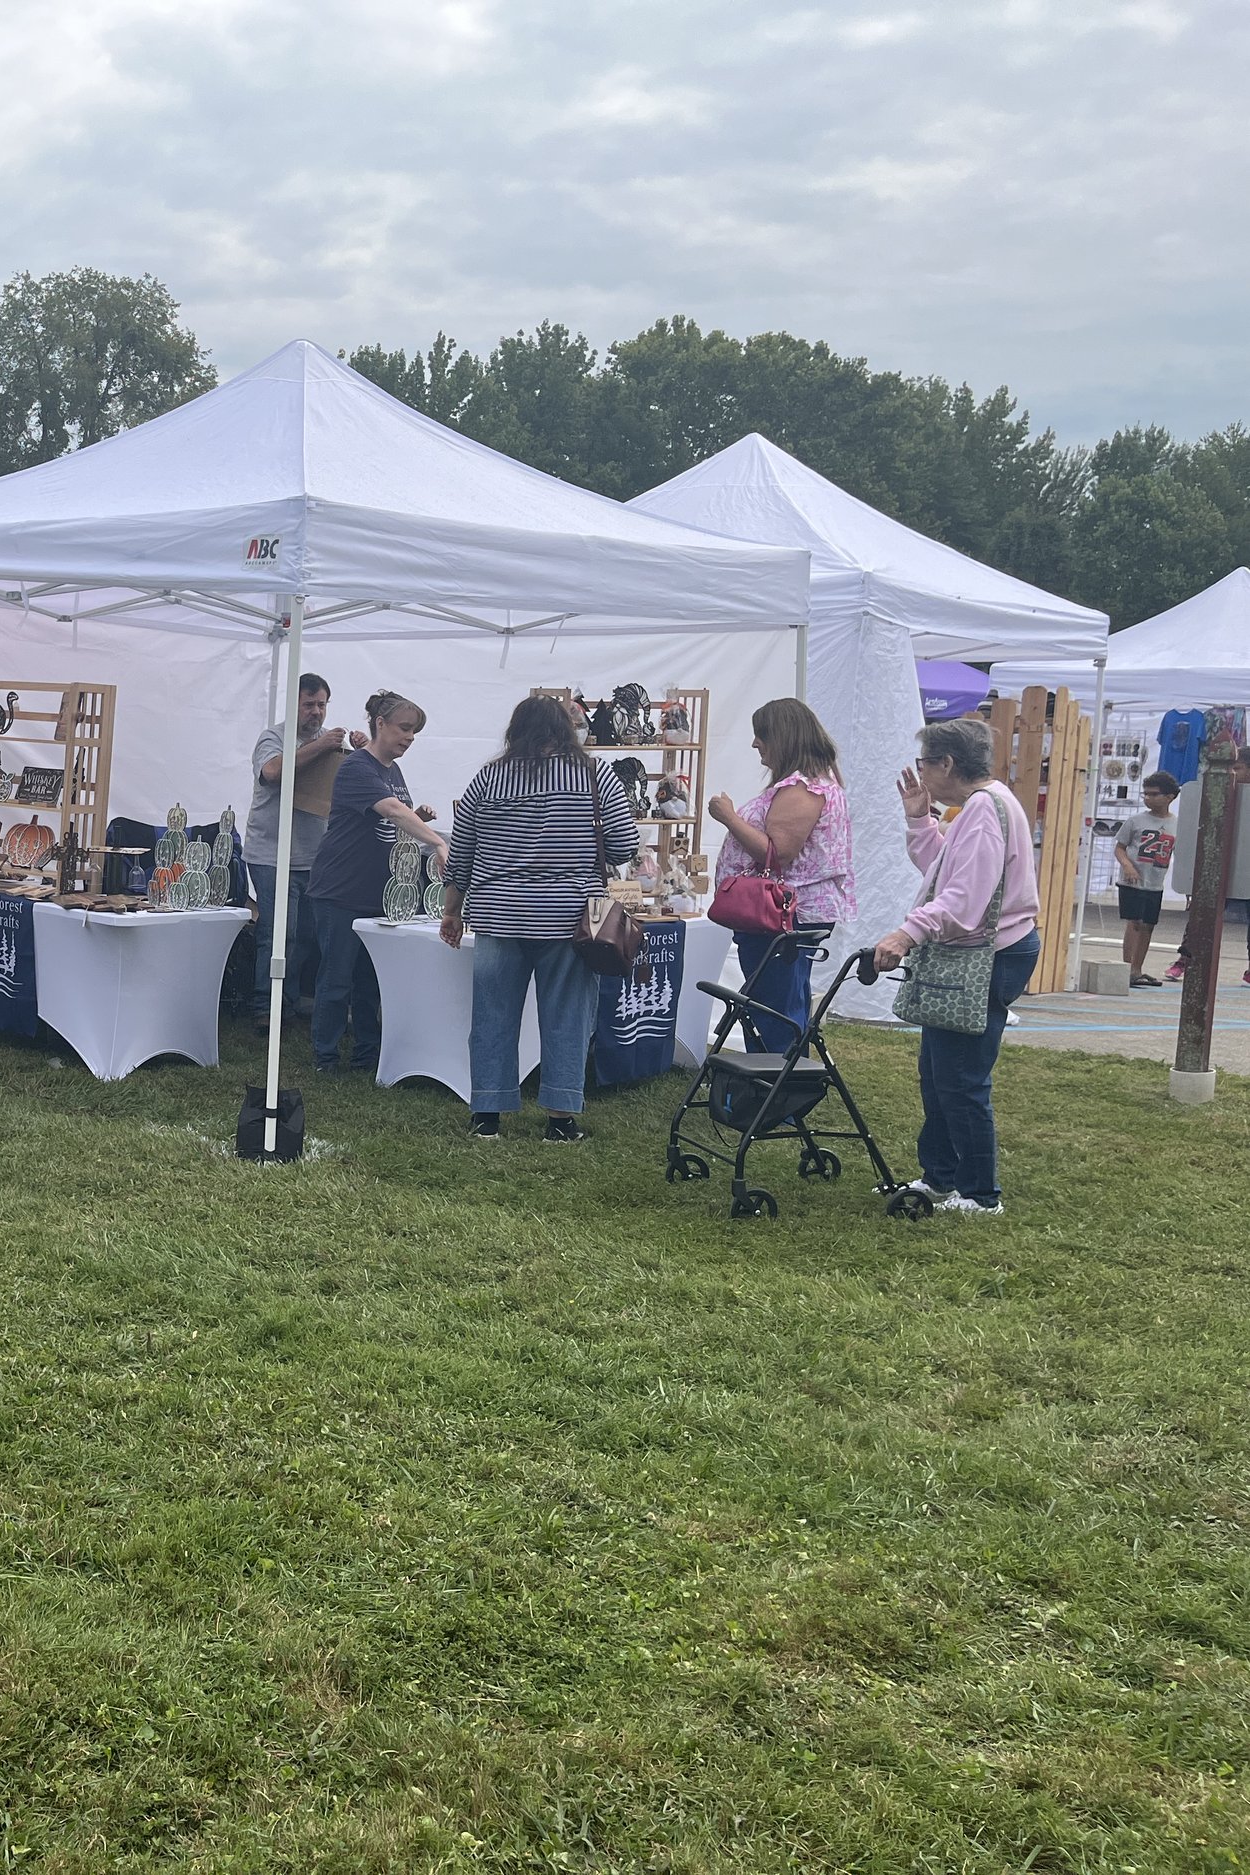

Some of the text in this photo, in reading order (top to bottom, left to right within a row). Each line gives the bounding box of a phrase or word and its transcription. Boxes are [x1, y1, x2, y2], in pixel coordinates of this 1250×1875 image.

[247, 539, 280, 559] ABC
[24, 773, 61, 789] WHISKEY
[30, 785, 47, 795] BAR
[1137, 829, 1175, 868] 23
